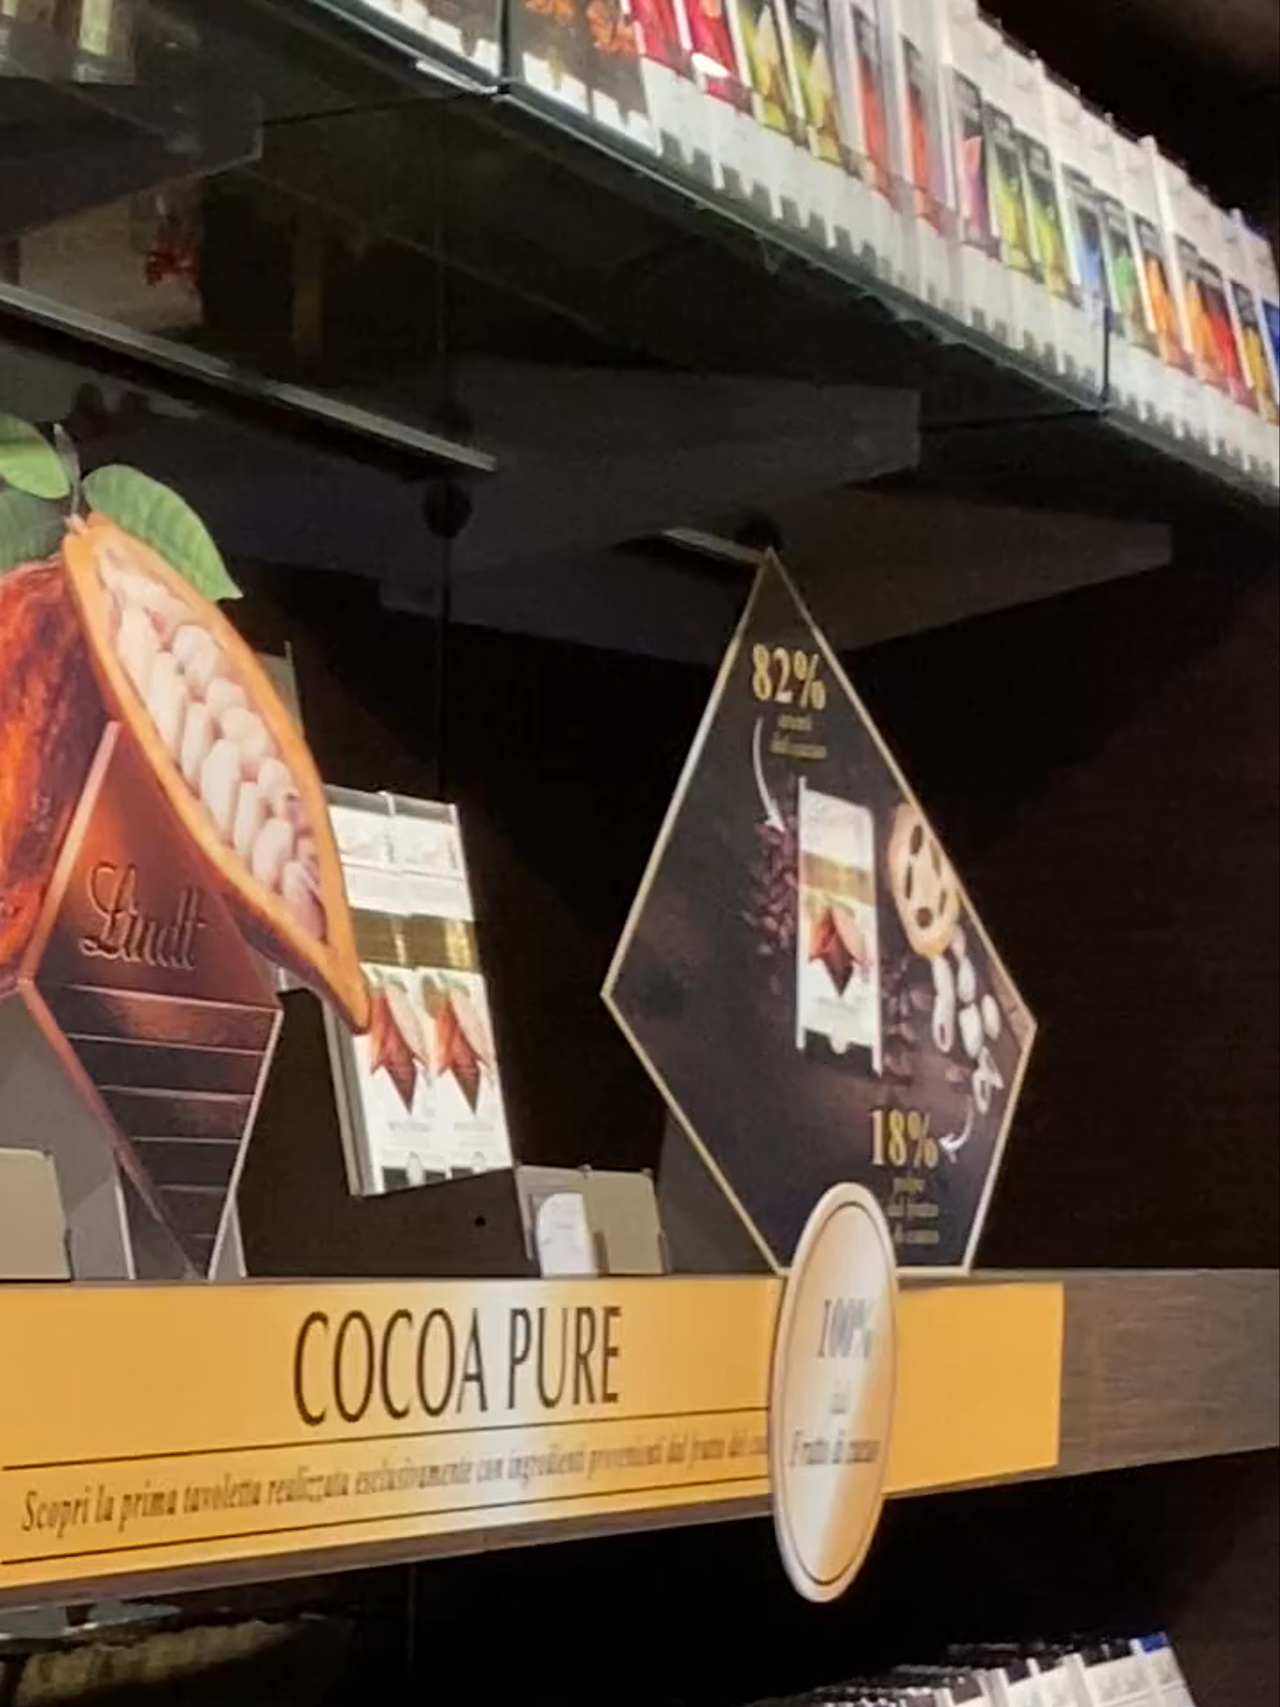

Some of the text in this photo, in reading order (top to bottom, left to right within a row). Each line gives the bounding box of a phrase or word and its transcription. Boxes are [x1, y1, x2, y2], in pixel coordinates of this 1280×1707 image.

[753, 644, 826, 710] 82%
[79, 860, 207, 973] Lindt
[870, 1109, 938, 1168] 18%
[293, 1304, 621, 1426] COCOA PURE
[21, 1486, 90, 1538] Scopri
[94, 1484, 113, 1522] la
[118, 1481, 175, 1533] prima
